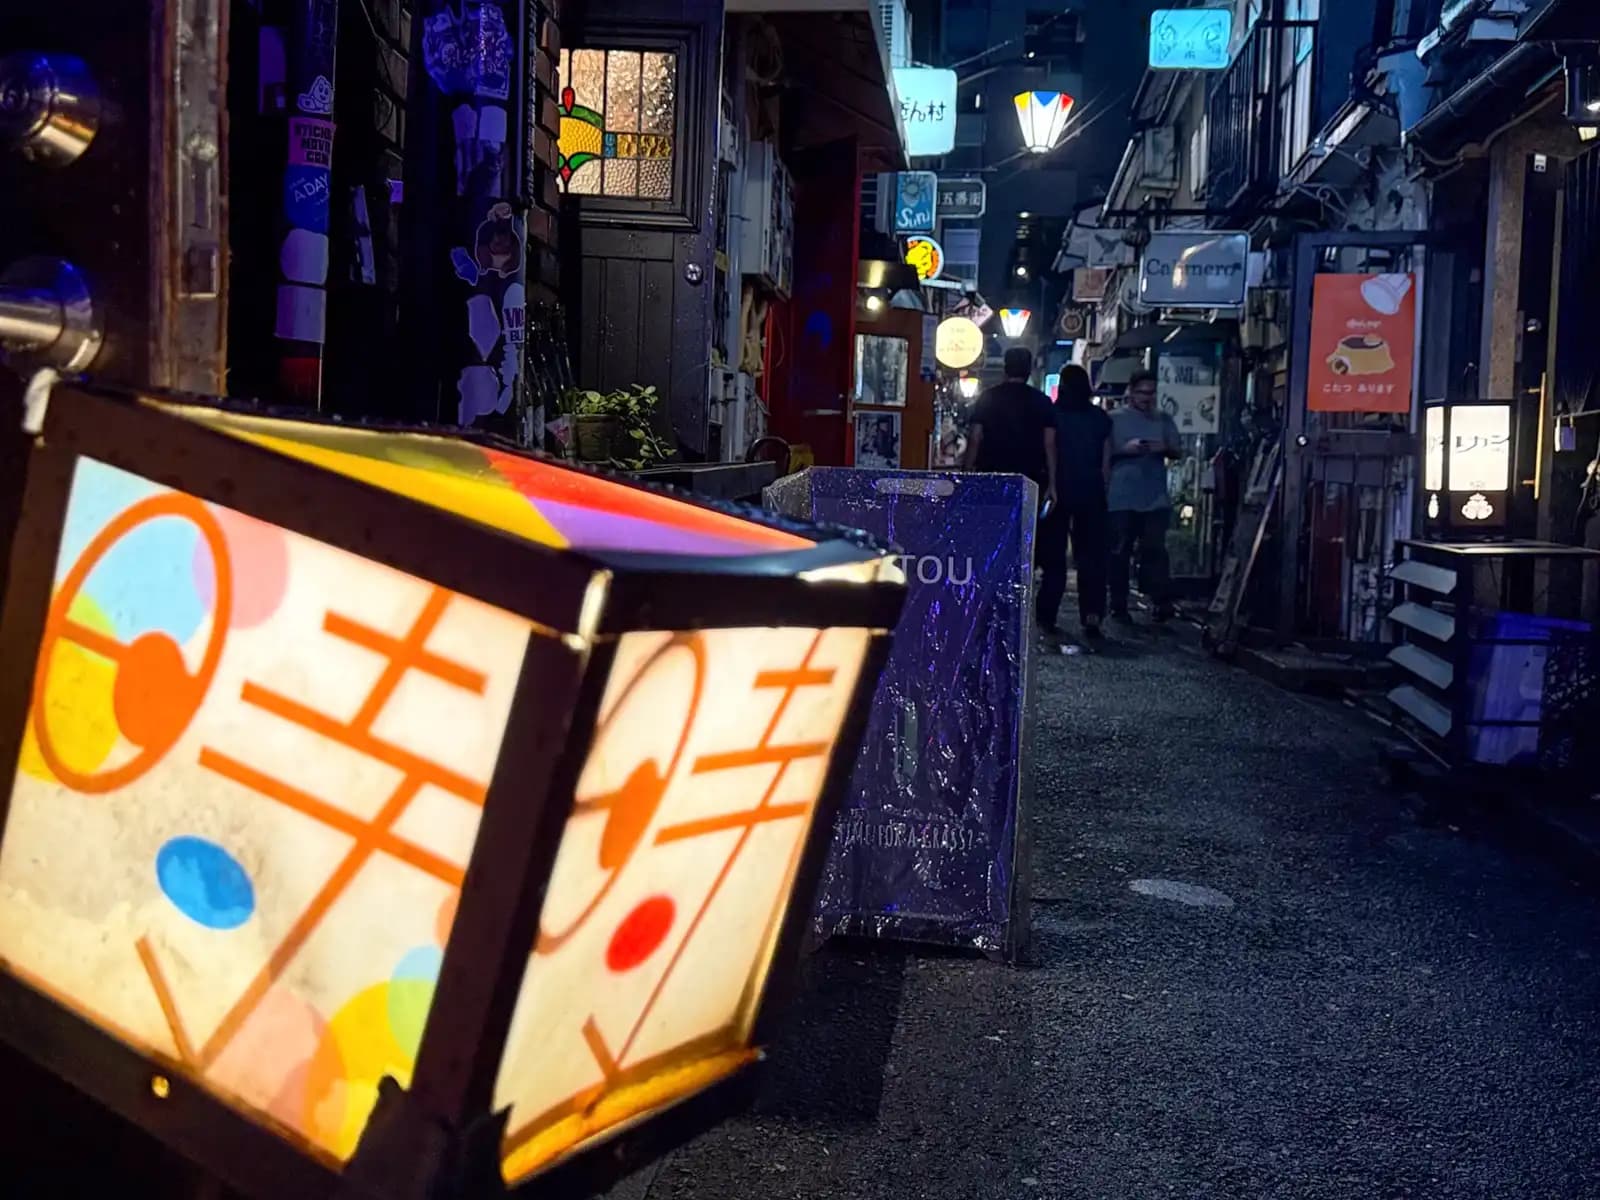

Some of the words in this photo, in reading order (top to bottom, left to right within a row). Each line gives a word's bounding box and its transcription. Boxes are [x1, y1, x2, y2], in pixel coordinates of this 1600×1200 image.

[937, 191, 981, 207] 五番街
[1147, 258, 1234, 277] Camero
[1322, 383, 1352, 393] こたつ
[1357, 383, 1396, 394] あります
